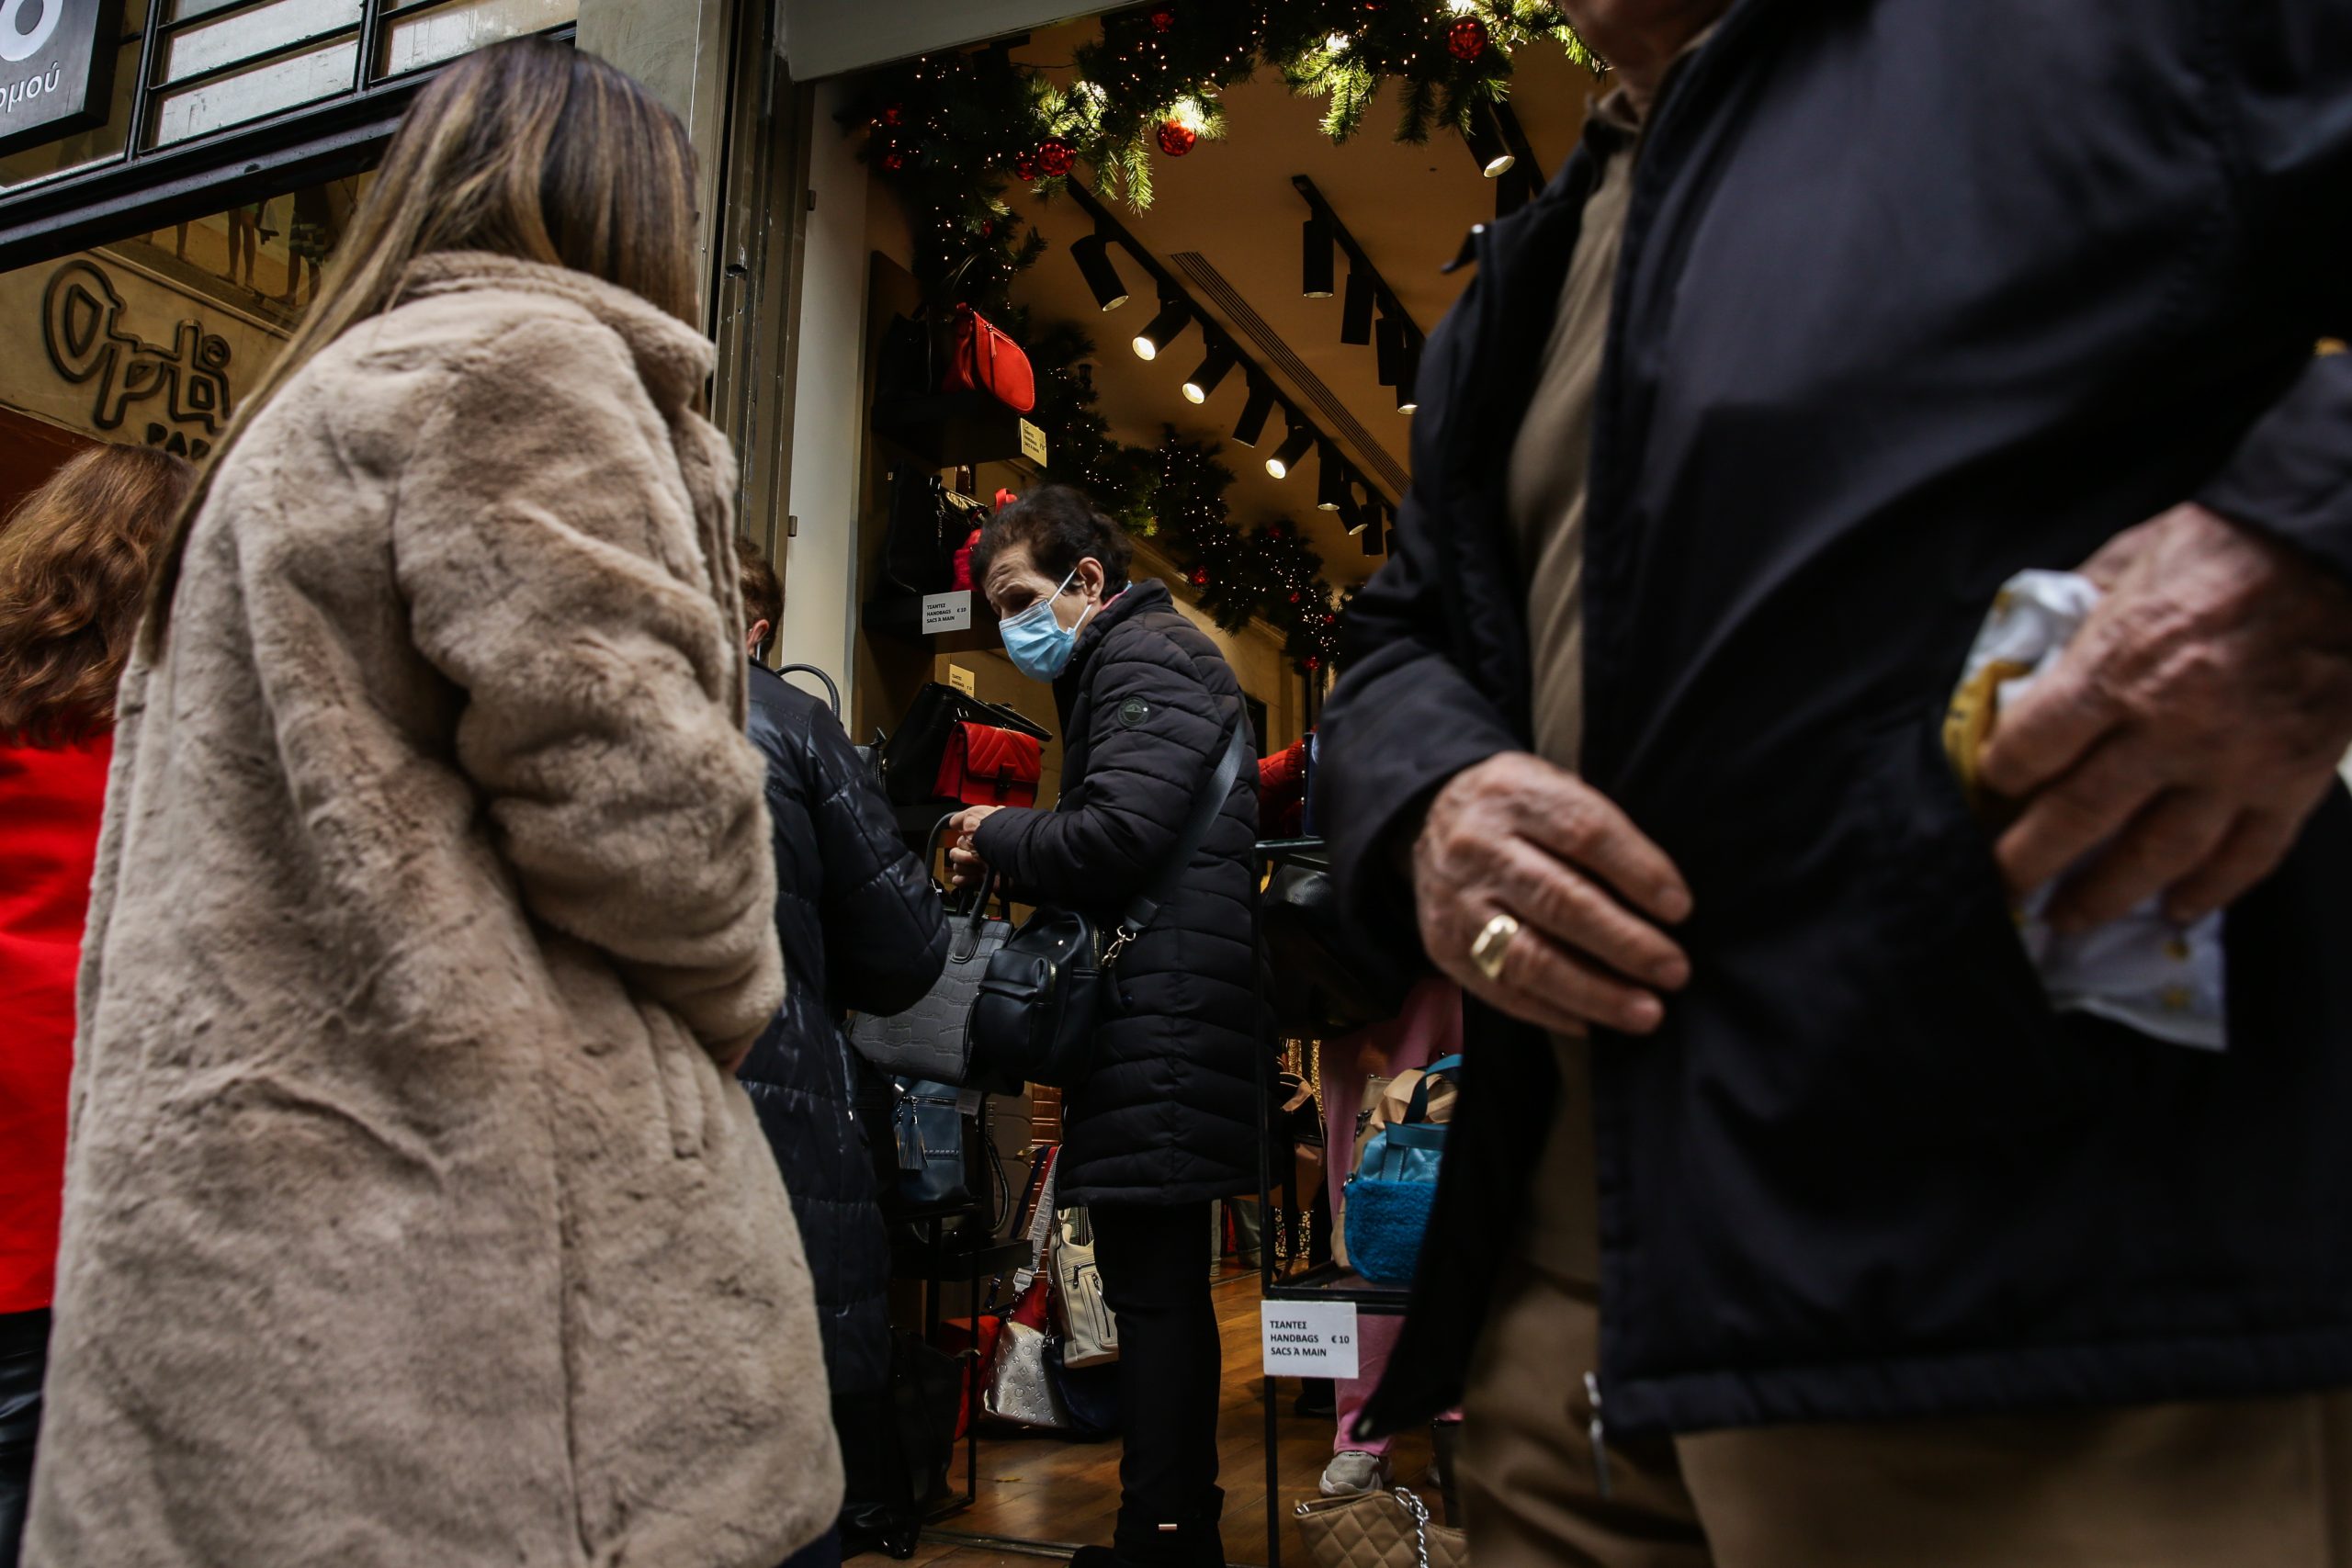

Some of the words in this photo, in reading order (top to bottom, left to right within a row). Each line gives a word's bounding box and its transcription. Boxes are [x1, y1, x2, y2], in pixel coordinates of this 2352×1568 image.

[1270, 1334, 1318, 1343] HANDBAGS
[1331, 1335, 1337, 1344] €
[1340, 1336, 1350, 1344] 10
[1271, 1347, 1292, 1356] SACS
[1302, 1348, 1327, 1357] MAIN
